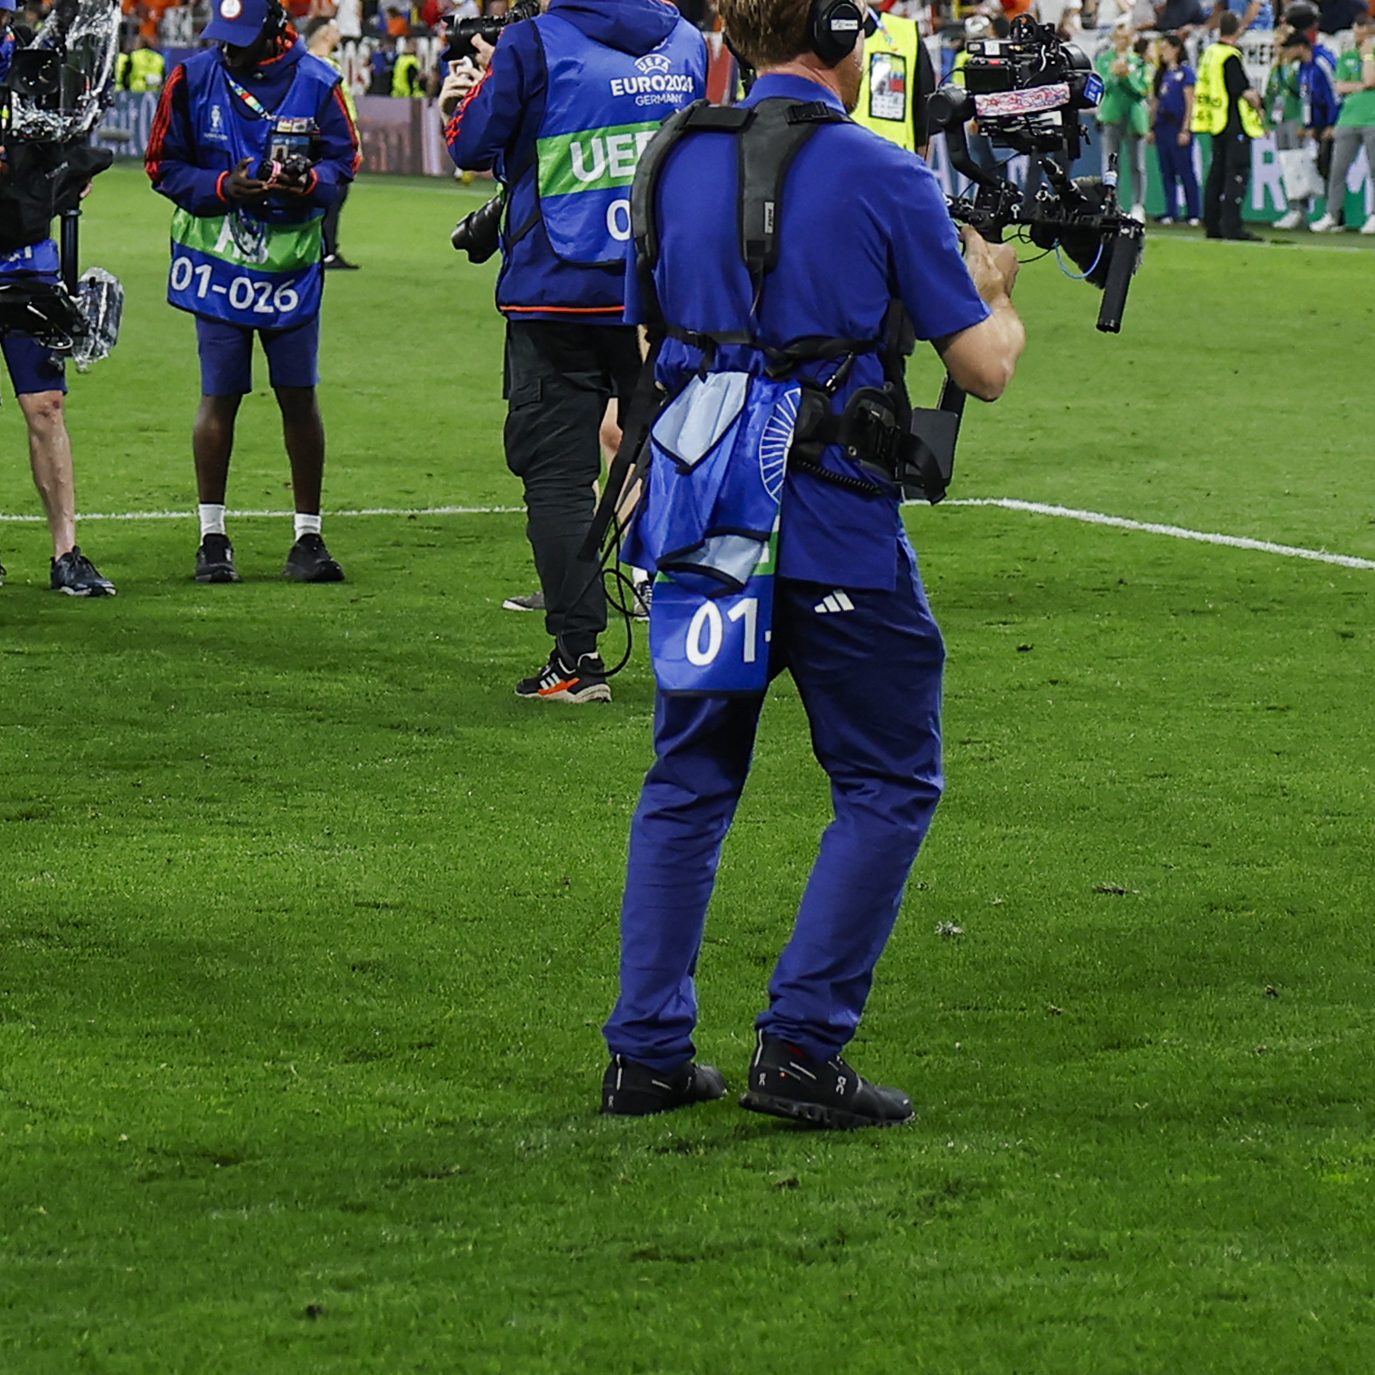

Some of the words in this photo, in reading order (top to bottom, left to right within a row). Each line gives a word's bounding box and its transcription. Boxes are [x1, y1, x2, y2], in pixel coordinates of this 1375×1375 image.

[637, 57, 669, 72] UEFA
[610, 75, 694, 96] EURO2024
[635, 93, 683, 106] GERMANY
[171, 256, 299, 313] 01-026
